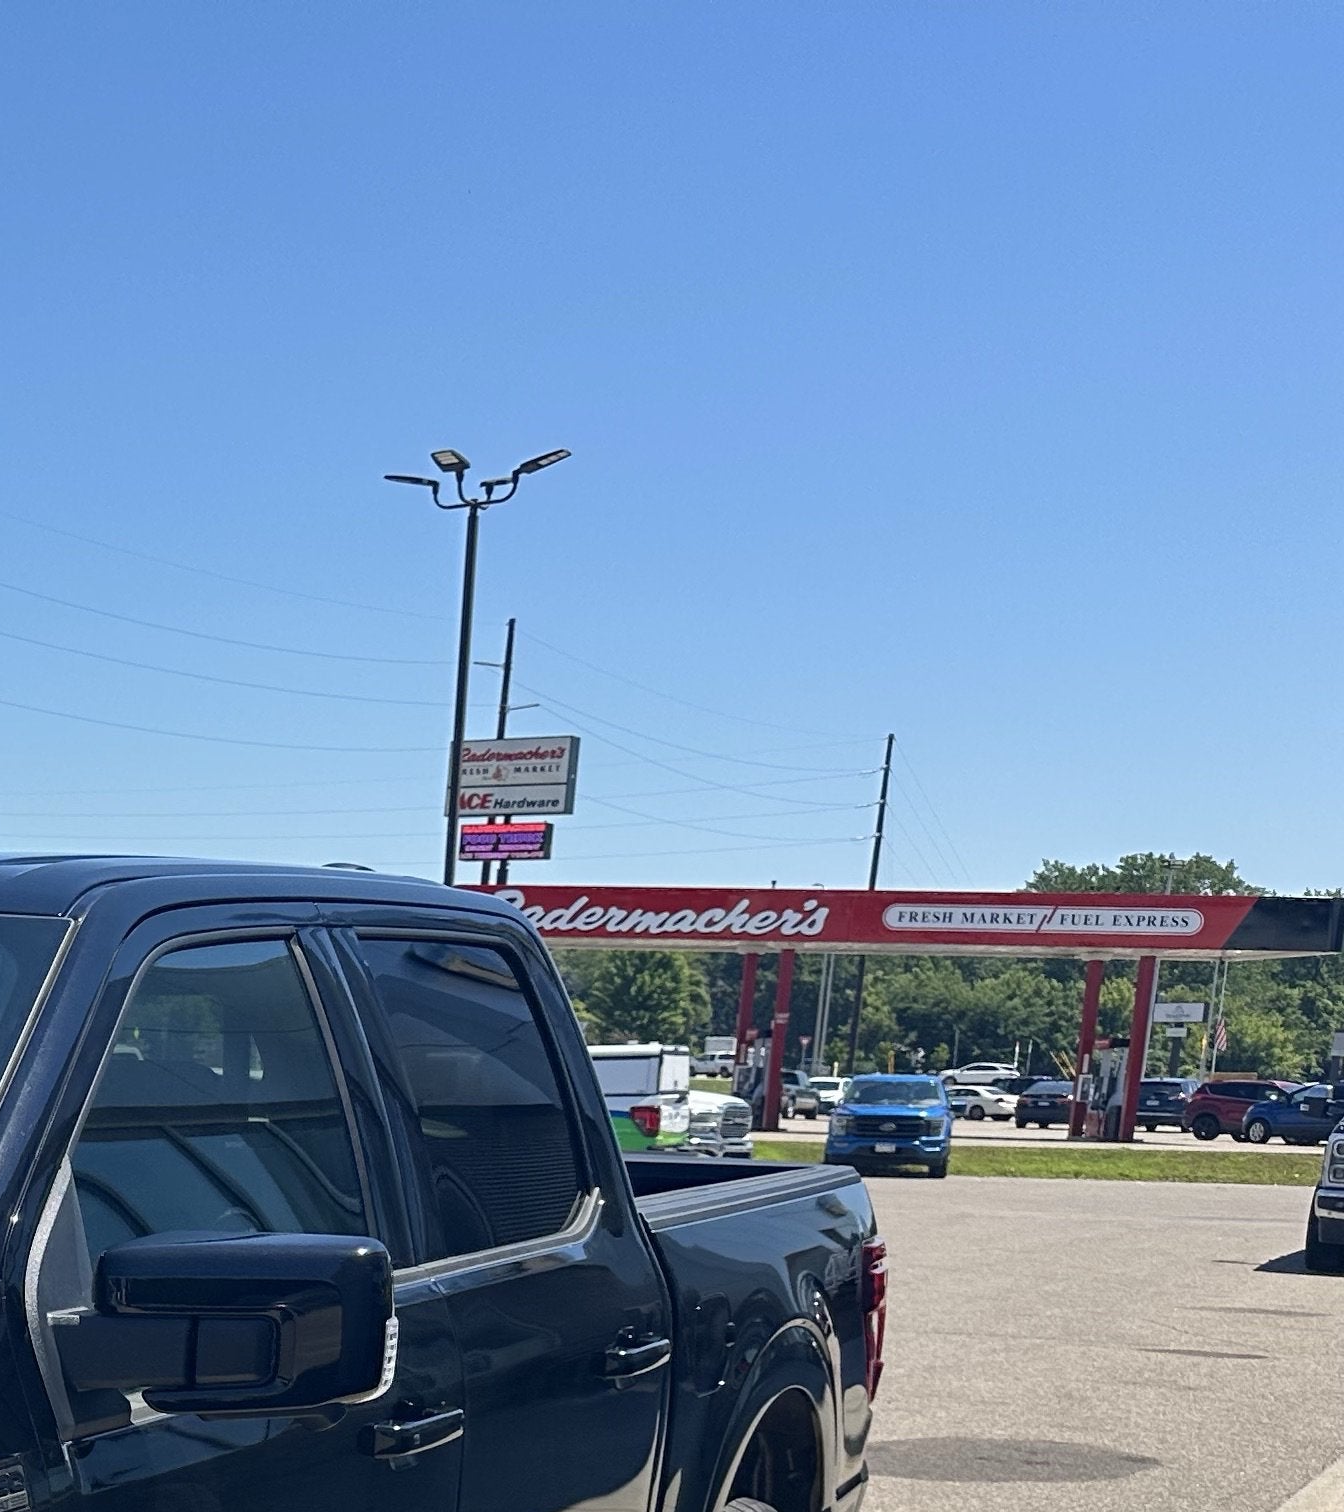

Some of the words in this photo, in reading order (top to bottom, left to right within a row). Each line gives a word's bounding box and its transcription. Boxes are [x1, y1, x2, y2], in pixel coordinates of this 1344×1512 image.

[462, 768, 489, 776] RESH
[514, 764, 560, 773] MARKET
[493, 797, 560, 809] Hardware
[897, 910, 954, 924] FRESH
[961, 911, 1038, 926] MARKET
[1060, 914, 1105, 927] FUEL
[1112, 914, 1190, 929] EXPRESS
